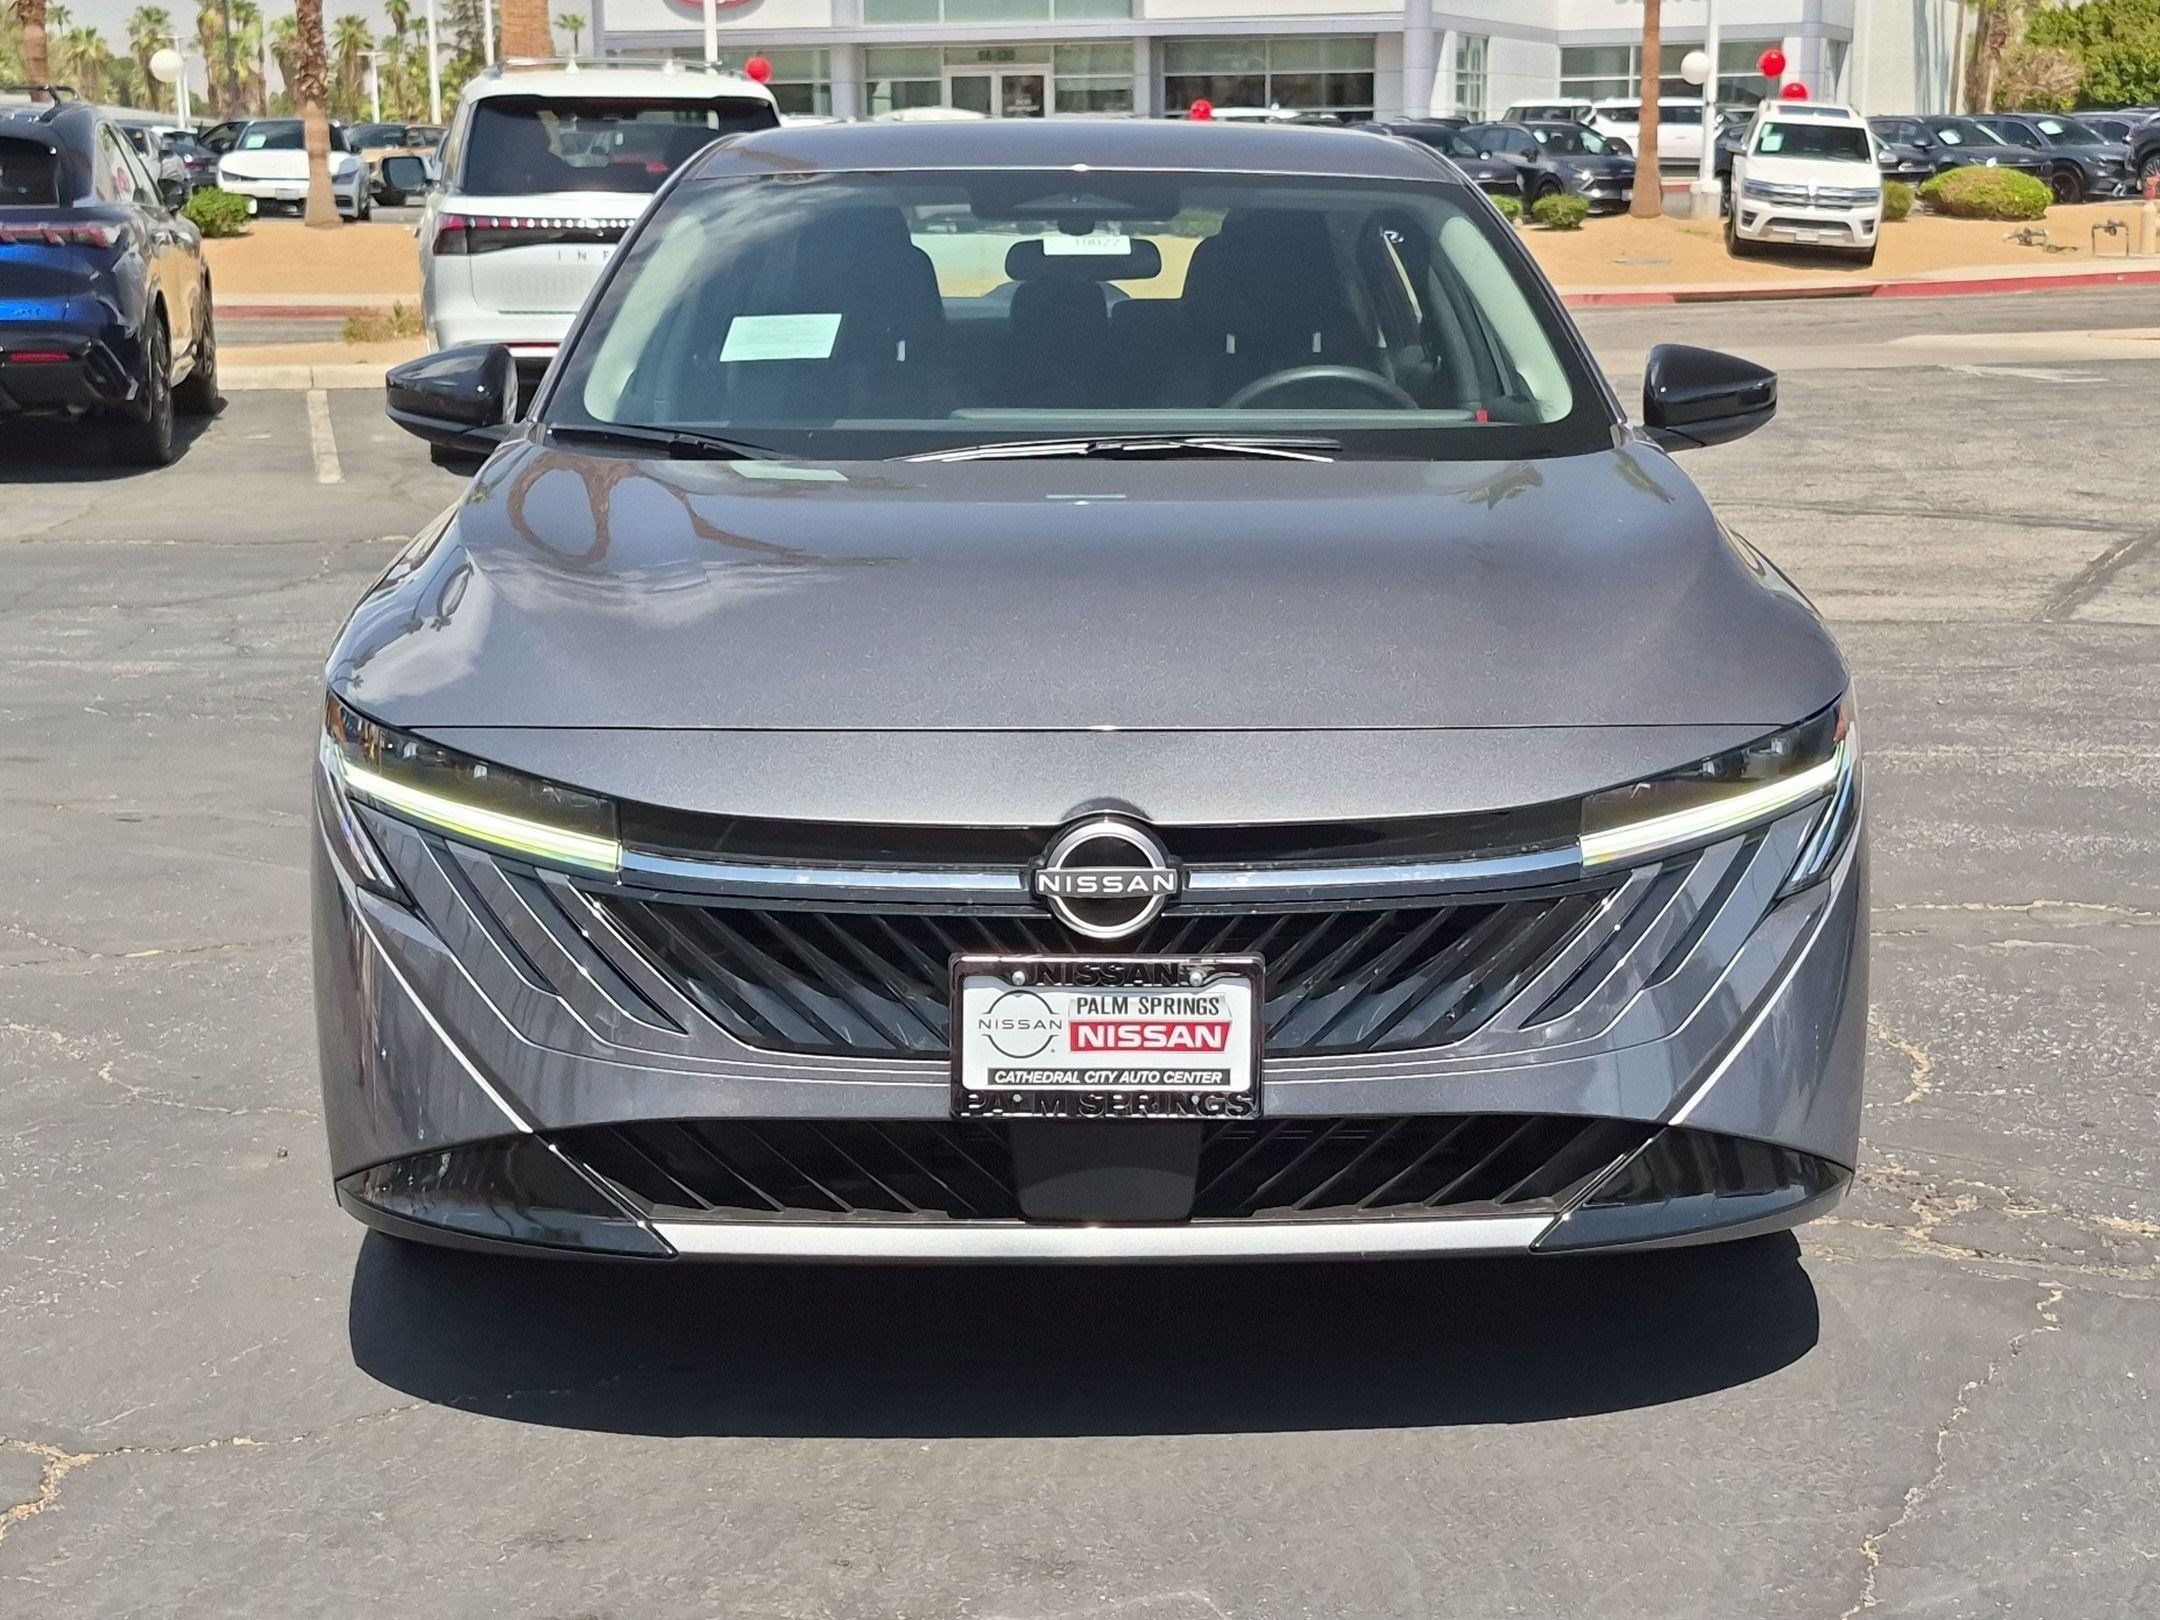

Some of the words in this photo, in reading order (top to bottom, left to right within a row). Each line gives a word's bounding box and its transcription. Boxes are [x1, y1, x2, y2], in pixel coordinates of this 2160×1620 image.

[1038, 873, 1175, 893] NISSAN
[1033, 962, 1180, 986] NISSAN
[1076, 996, 1129, 1016] PALM
[1138, 996, 1220, 1016] SPRINGS
[978, 1018, 1063, 1030] NISSAN
[1078, 1024, 1222, 1048] NISSAN
[994, 1070, 1081, 1084] CATHEDRAL
[1083, 1070, 1118, 1084] CITY
[1119, 1070, 1161, 1084] AUTO
[1163, 1070, 1223, 1084] CENTER
[961, 1093, 1068, 1117] PALM
[1078, 1093, 1253, 1118] SPRINGS
